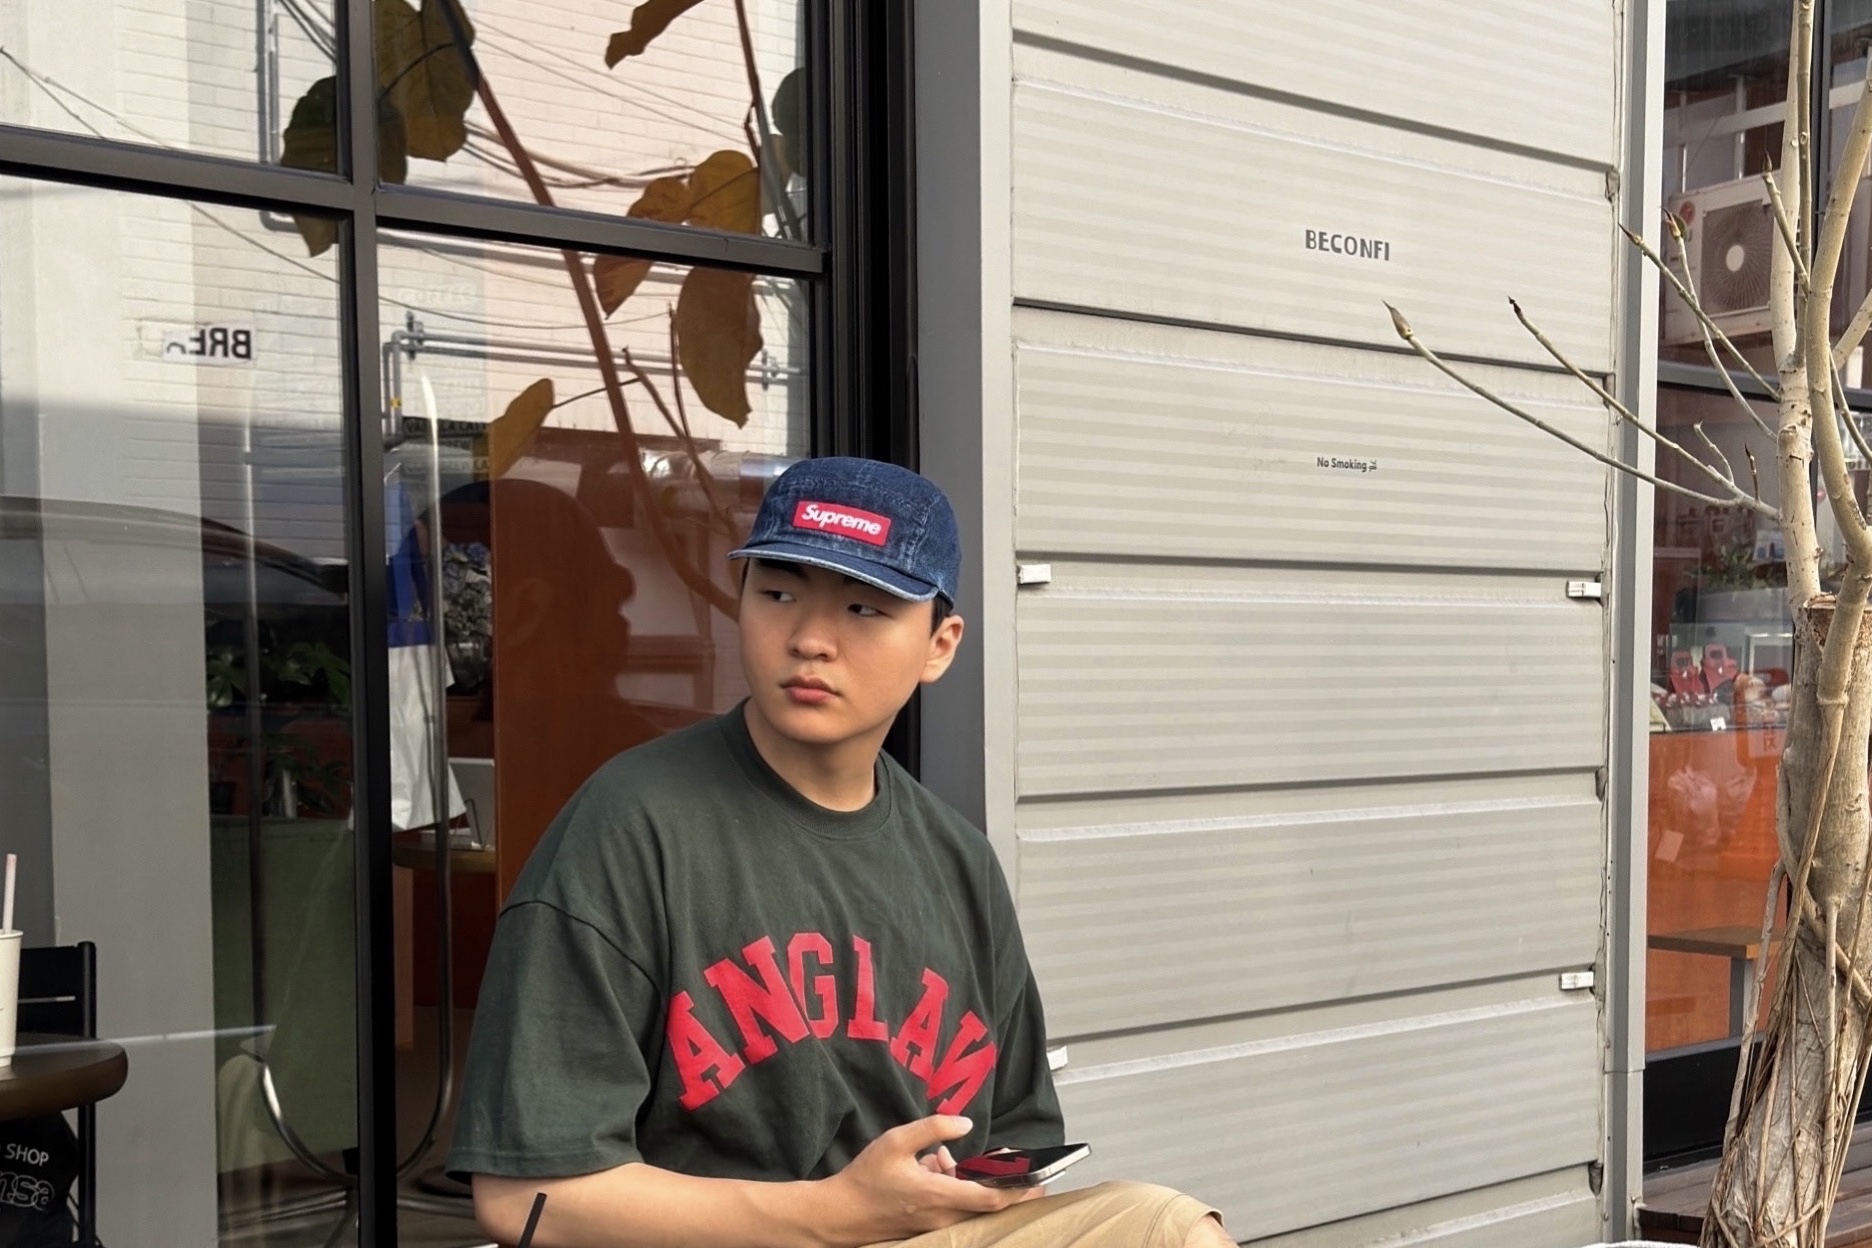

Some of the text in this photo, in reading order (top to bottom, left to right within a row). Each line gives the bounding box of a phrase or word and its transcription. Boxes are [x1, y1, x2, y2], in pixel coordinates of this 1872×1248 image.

[1305, 229, 1390, 261] BECONFI
[1317, 456, 1367, 473] No Smoking
[801, 504, 882, 535] Supreme
[667, 932, 997, 1116] ANGLAN
[4, 1143, 49, 1167] SHOP
